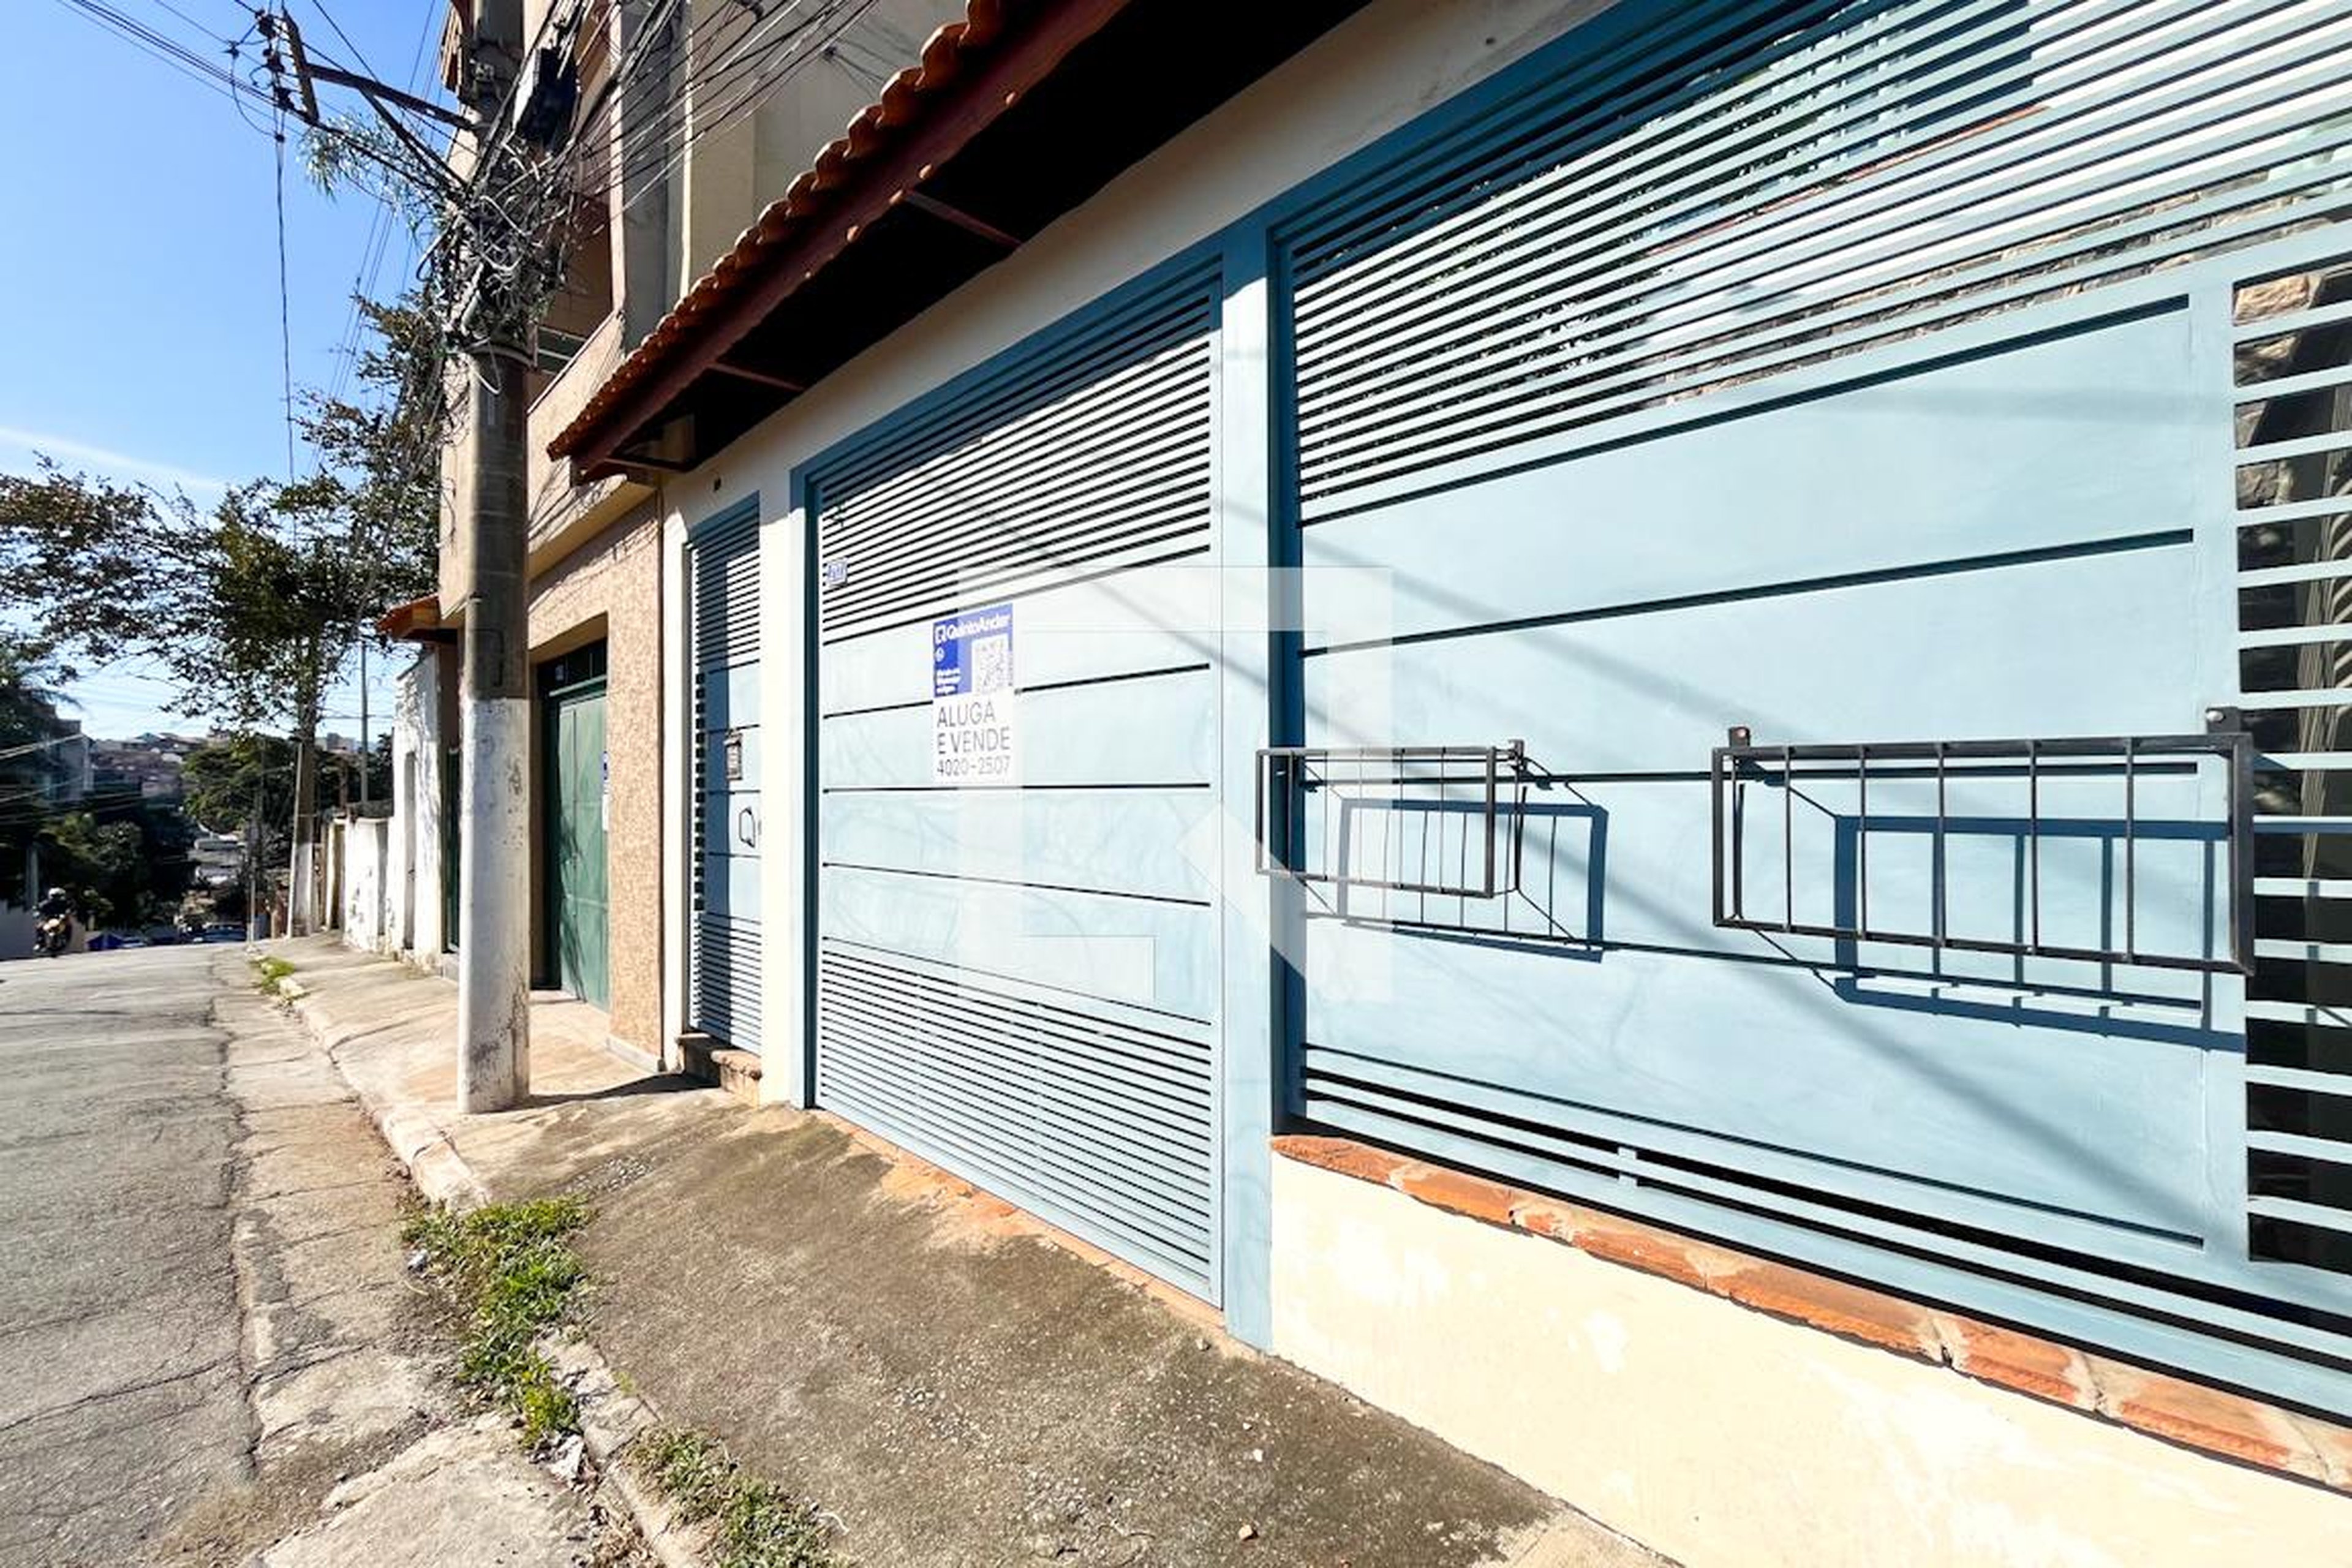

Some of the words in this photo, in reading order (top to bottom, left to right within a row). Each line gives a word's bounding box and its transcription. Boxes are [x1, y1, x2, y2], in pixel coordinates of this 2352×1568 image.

[937, 701, 996, 728] ALUGA
[938, 733, 946, 754] E
[950, 726, 1010, 753] VENDE
[937, 755, 1010, 776] 4020-2507
